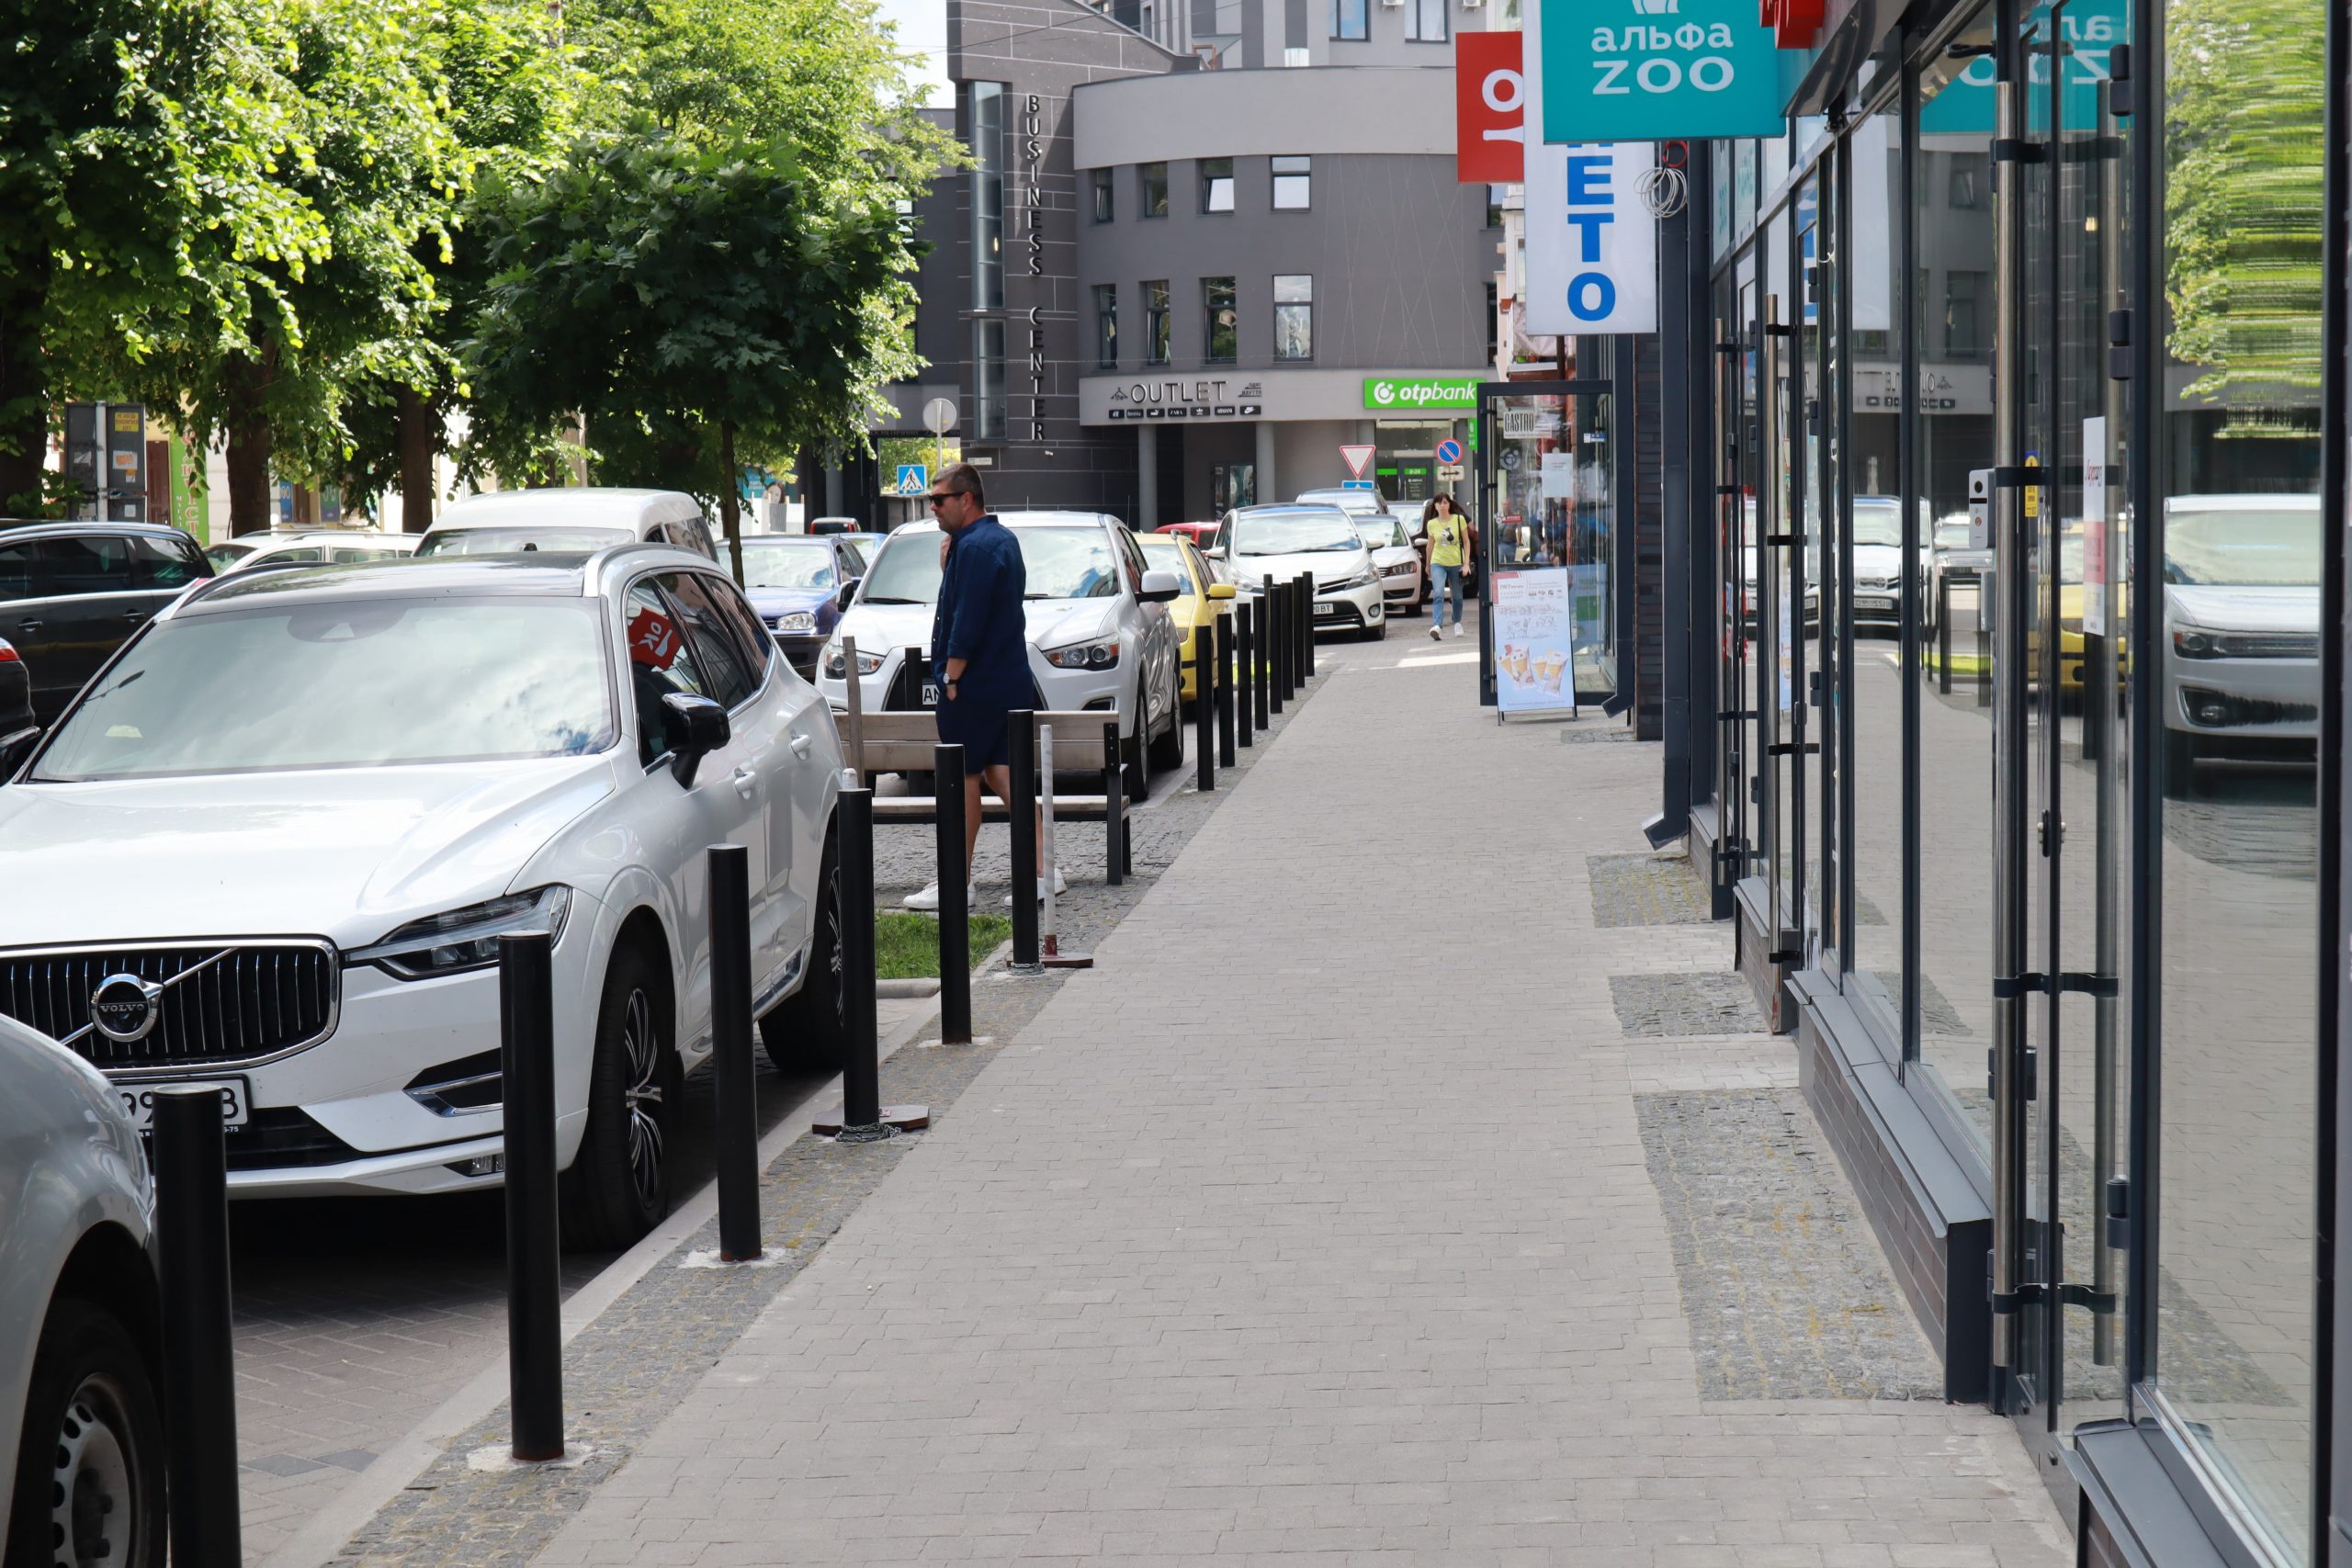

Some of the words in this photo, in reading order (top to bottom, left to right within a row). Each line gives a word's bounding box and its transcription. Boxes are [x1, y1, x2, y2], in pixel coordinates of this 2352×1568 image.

[1590, 22, 1734, 52] альфа
[1592, 56, 1735, 96] ZOO
[1025, 95, 1043, 276] BUSINESS
[1029, 306, 1046, 441] CENTER
[1130, 380, 1228, 404] OUTLET
[1399, 382, 1476, 406] otpbank
[99, 1003, 145, 1012] VOLVO
